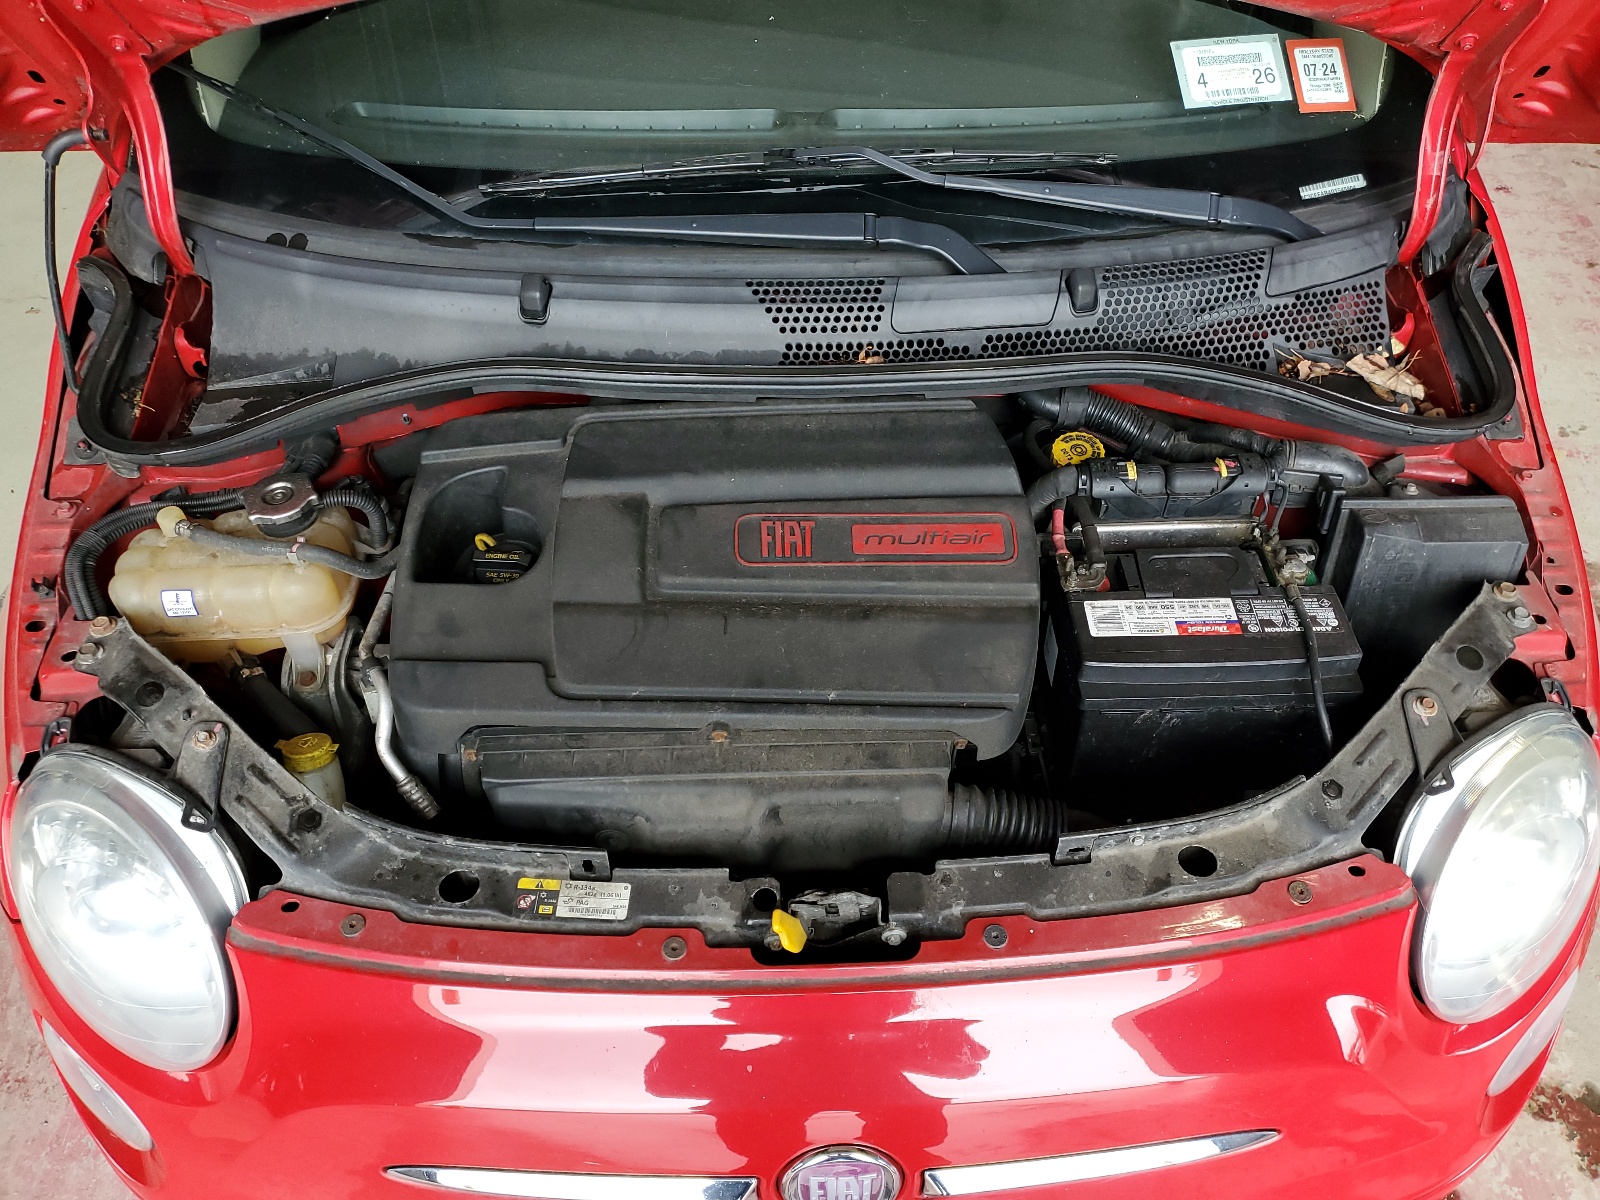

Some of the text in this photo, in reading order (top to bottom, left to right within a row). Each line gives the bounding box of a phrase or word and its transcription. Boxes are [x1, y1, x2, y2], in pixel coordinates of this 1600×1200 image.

[1197, 72, 1208, 88] 4
[1252, 67, 1276, 84] 26
[759, 520, 992, 558] FIAT multiair
[1187, 625, 1231, 634] Duralast
[808, 1173, 878, 1200] FIAT
